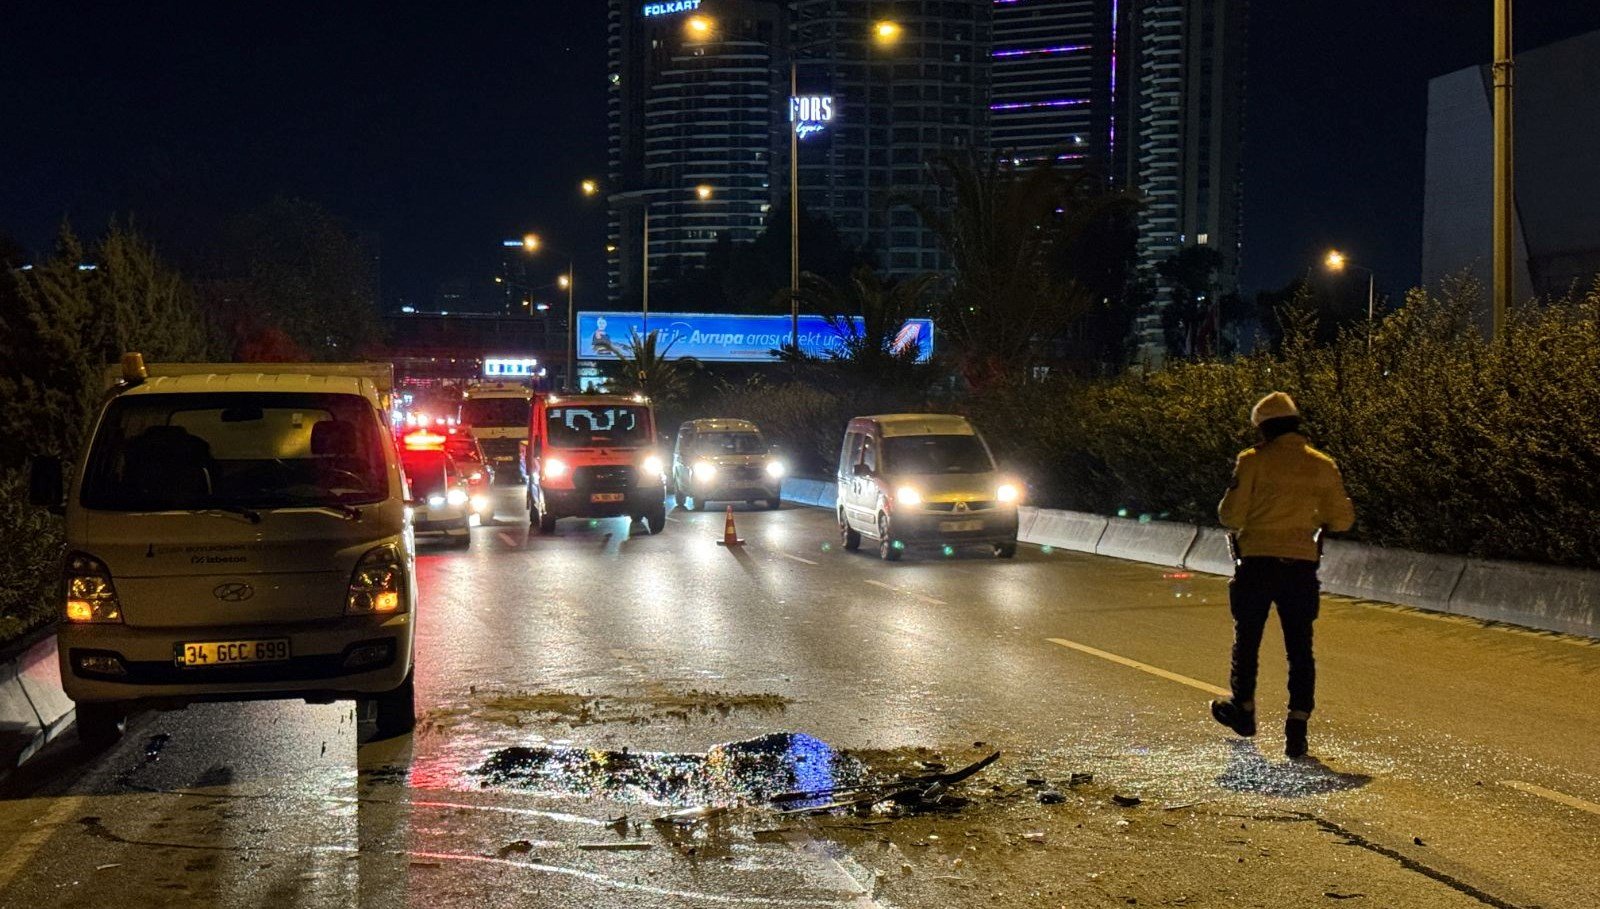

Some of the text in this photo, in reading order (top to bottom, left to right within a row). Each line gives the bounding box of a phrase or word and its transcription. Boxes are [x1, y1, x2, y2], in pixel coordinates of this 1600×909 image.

[645, 0, 701, 16] FOLKART
[790, 97, 832, 121] FORS
[689, 330, 744, 347] Avrupa
[746, 333, 780, 346] arası
[186, 645, 208, 663] 34
[217, 643, 249, 662] GCC
[255, 641, 287, 660] 699
